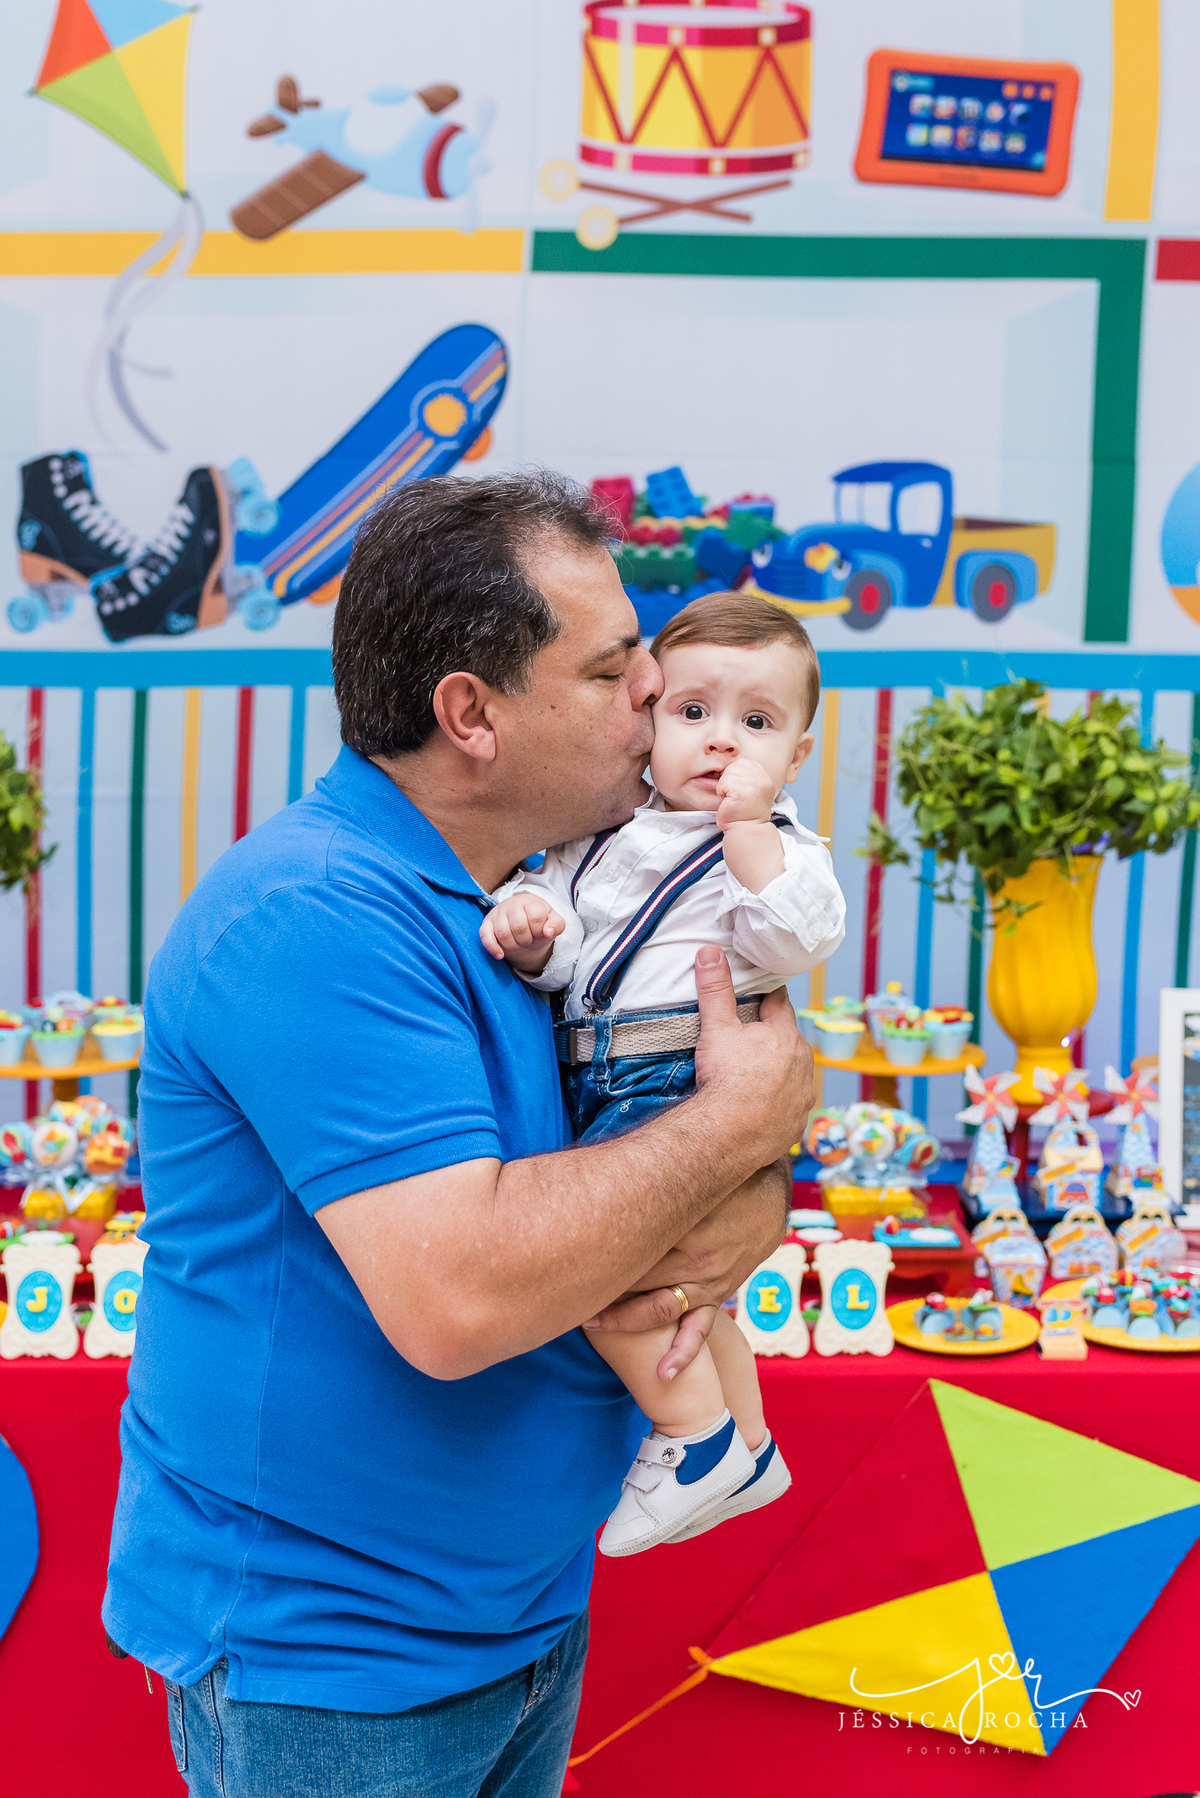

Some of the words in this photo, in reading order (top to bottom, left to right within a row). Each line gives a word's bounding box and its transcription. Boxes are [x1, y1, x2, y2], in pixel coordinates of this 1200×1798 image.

[26, 1286, 48, 1312] J
[114, 1288, 138, 1314] O
[757, 1285, 782, 1313] E
[846, 1285, 869, 1310] L
